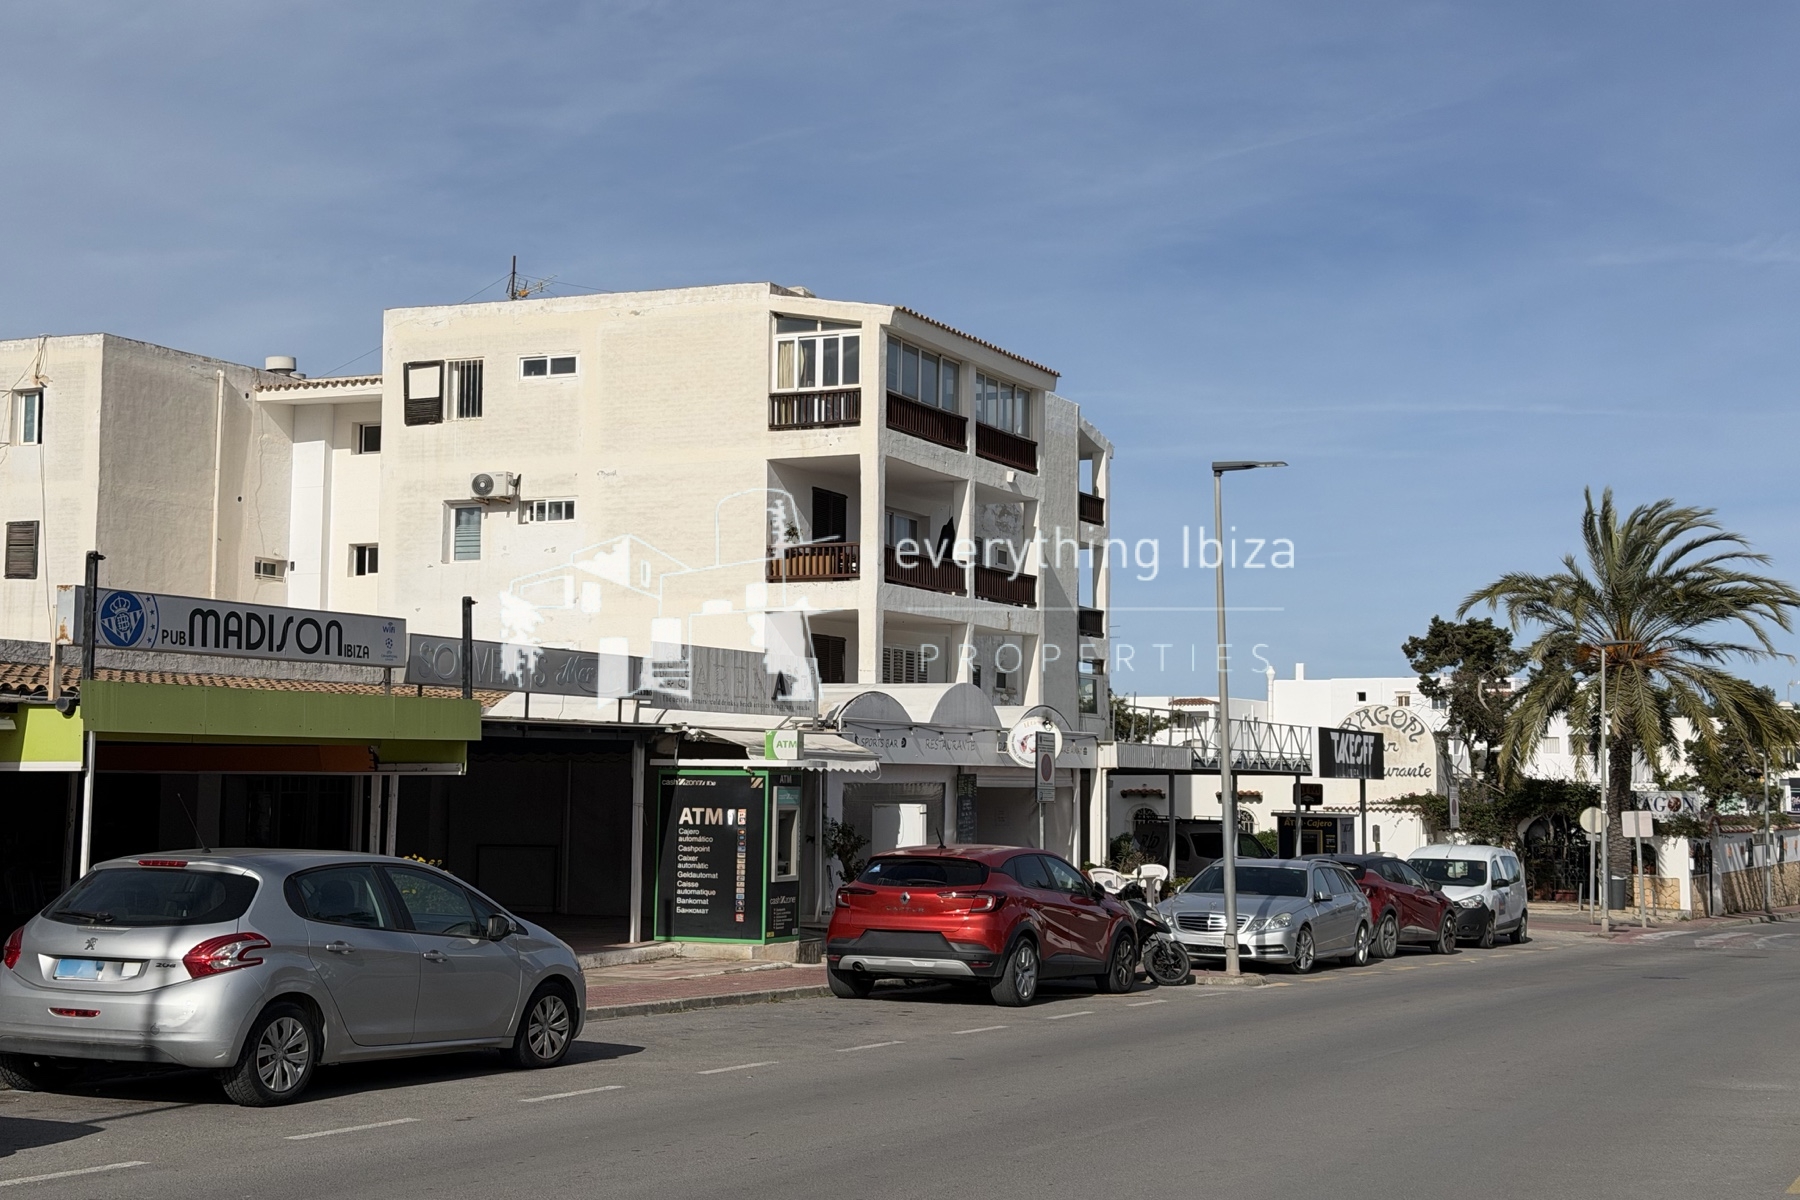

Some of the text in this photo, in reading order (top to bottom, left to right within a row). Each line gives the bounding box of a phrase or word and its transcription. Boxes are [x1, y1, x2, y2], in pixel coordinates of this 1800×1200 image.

[161, 629, 186, 647] PUB
[188, 607, 342, 656] MADISON
[343, 643, 370, 659] IBIZA
[776, 739, 797, 749] ATM
[861, 737, 899, 748] SPORTS BAR
[925, 738, 976, 751] RESTAURANTE
[678, 807, 724, 826] ATM
[1307, 819, 1333, 829] Cajero
[678, 827, 700, 836] Cajero
[677, 844, 711, 853] Cashpoint
[677, 854, 699, 862] Caixer
[677, 870, 719, 879] Geldautomat
[676, 880, 699, 888] Caisse
[676, 888, 717, 897] automatique
[676, 897, 709, 905] Bankomat
[676, 906, 709, 914] Банкомат
